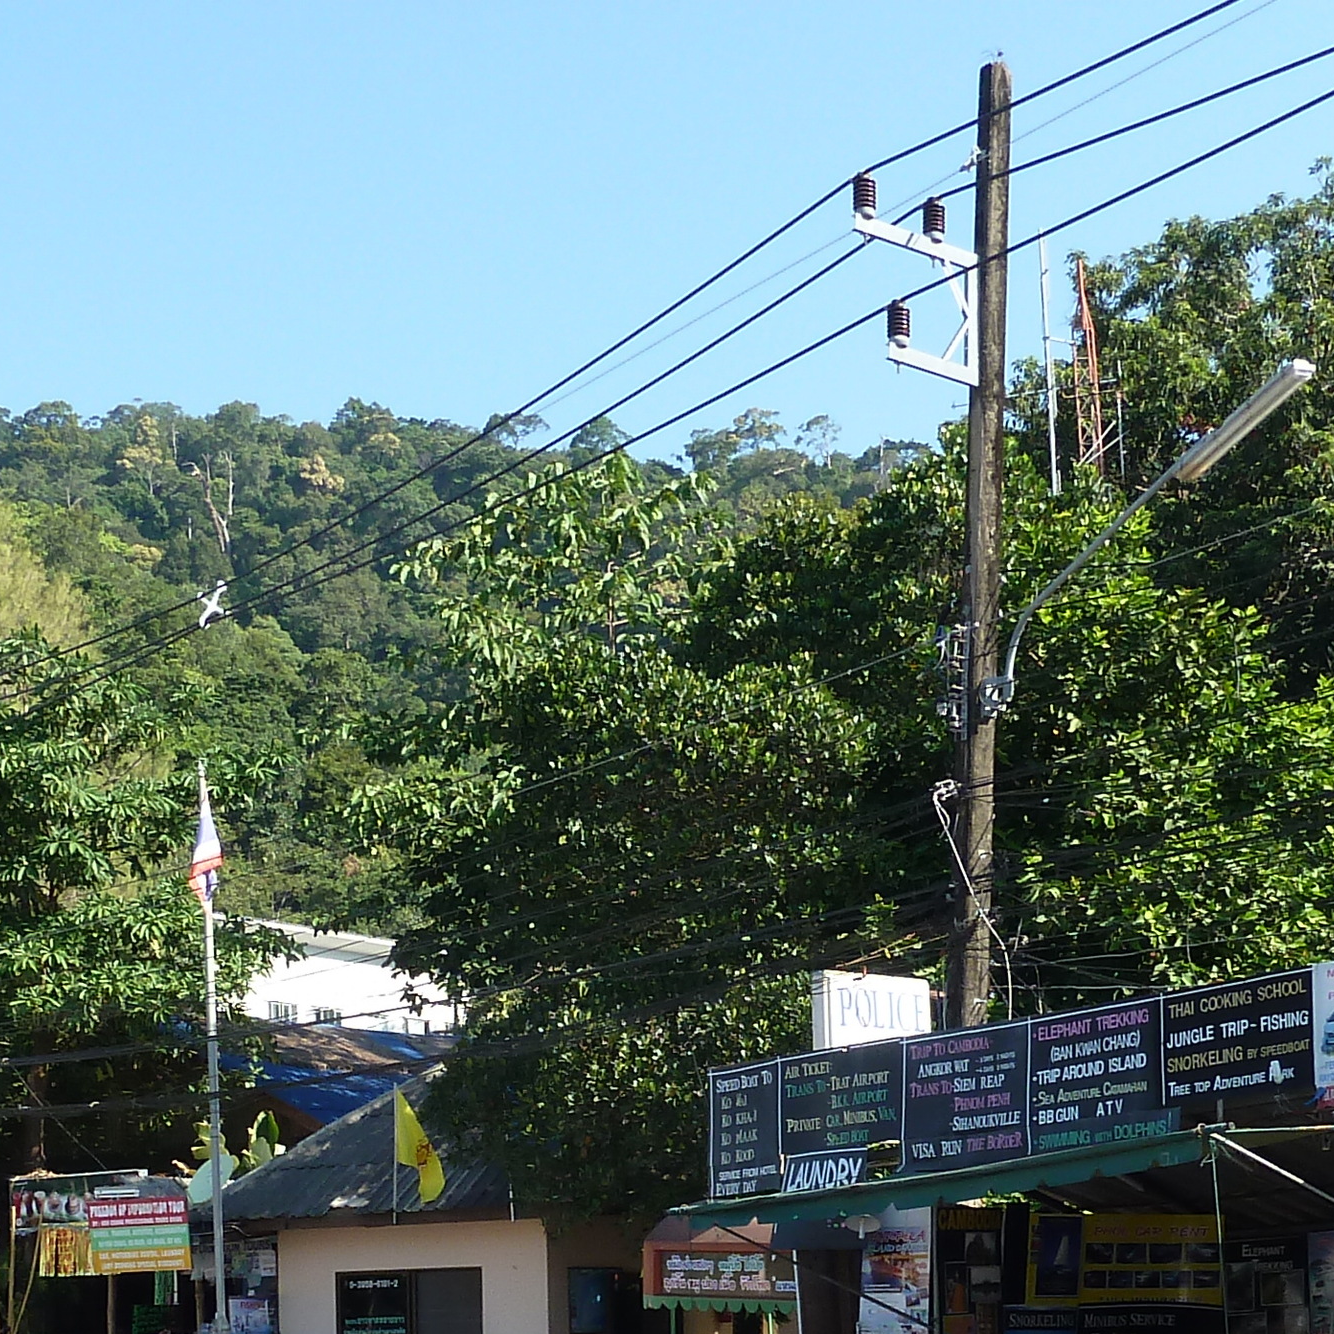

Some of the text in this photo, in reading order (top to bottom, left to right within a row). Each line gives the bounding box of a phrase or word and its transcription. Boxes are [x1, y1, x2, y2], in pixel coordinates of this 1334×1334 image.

[1168, 978, 1307, 1019] THAI COOKING SCHOOL
[837, 987, 925, 1032] POLICE
[1038, 1008, 1149, 1041] ELEPHANT TREKKING
[1167, 1025, 1215, 1049] JUNGLE
[1260, 1010, 1309, 1032] FISHING
[911, 1045, 931, 1060] TRIP
[933, 1042, 946, 1055] TO
[1051, 1029, 1140, 1063] (BAN KWAN CHANG)
[1167, 1038, 1310, 1073] SNORKELING BY SPEEDBOAT
[784, 1065, 801, 1080] AIR
[918, 1063, 952, 1079] ANGKOR
[954, 1059, 970, 1073] WAT
[1037, 1053, 1147, 1086] TRIP AROUND ISLAND
[716, 1070, 773, 1094] SPEED BOAT TO
[785, 1082, 815, 1098] TRANS
[852, 1071, 889, 1087] AIRPORT
[910, 1082, 939, 1098] TRANS
[980, 1074, 1005, 1089] REAP
[1168, 1081, 1191, 1097] TREE
[1194, 1081, 1211, 1093] TOP
[1213, 1071, 1266, 1091] ADVENTURE
[852, 1089, 888, 1104] AIRPORT
[987, 1092, 1011, 1108] PENH
[1038, 1091, 1055, 1105] SEA
[1057, 1087, 1101, 1103] ADVENTURE
[786, 1118, 821, 1133] PRIVATE
[851, 1130, 869, 1142] BOAT
[1039, 1111, 1172, 1149] SWIMMING WITH DOLPHINS!
[912, 1143, 936, 1159] VISA
[941, 1140, 962, 1156] RUN
[967, 1137, 986, 1151] THE
[719, 1164, 777, 1181] SERVICE FROM HOTEL
[786, 1157, 863, 1192] LAUNDRY
[716, 1180, 758, 1197] EVERY DAY
[1169, 1225, 1210, 1238] RENT
[1241, 1243, 1285, 1257] ELEPHANT
[1008, 1313, 1075, 1329] SNORKELING
[1084, 1313, 1176, 1328] MINIBUS SERVICE
